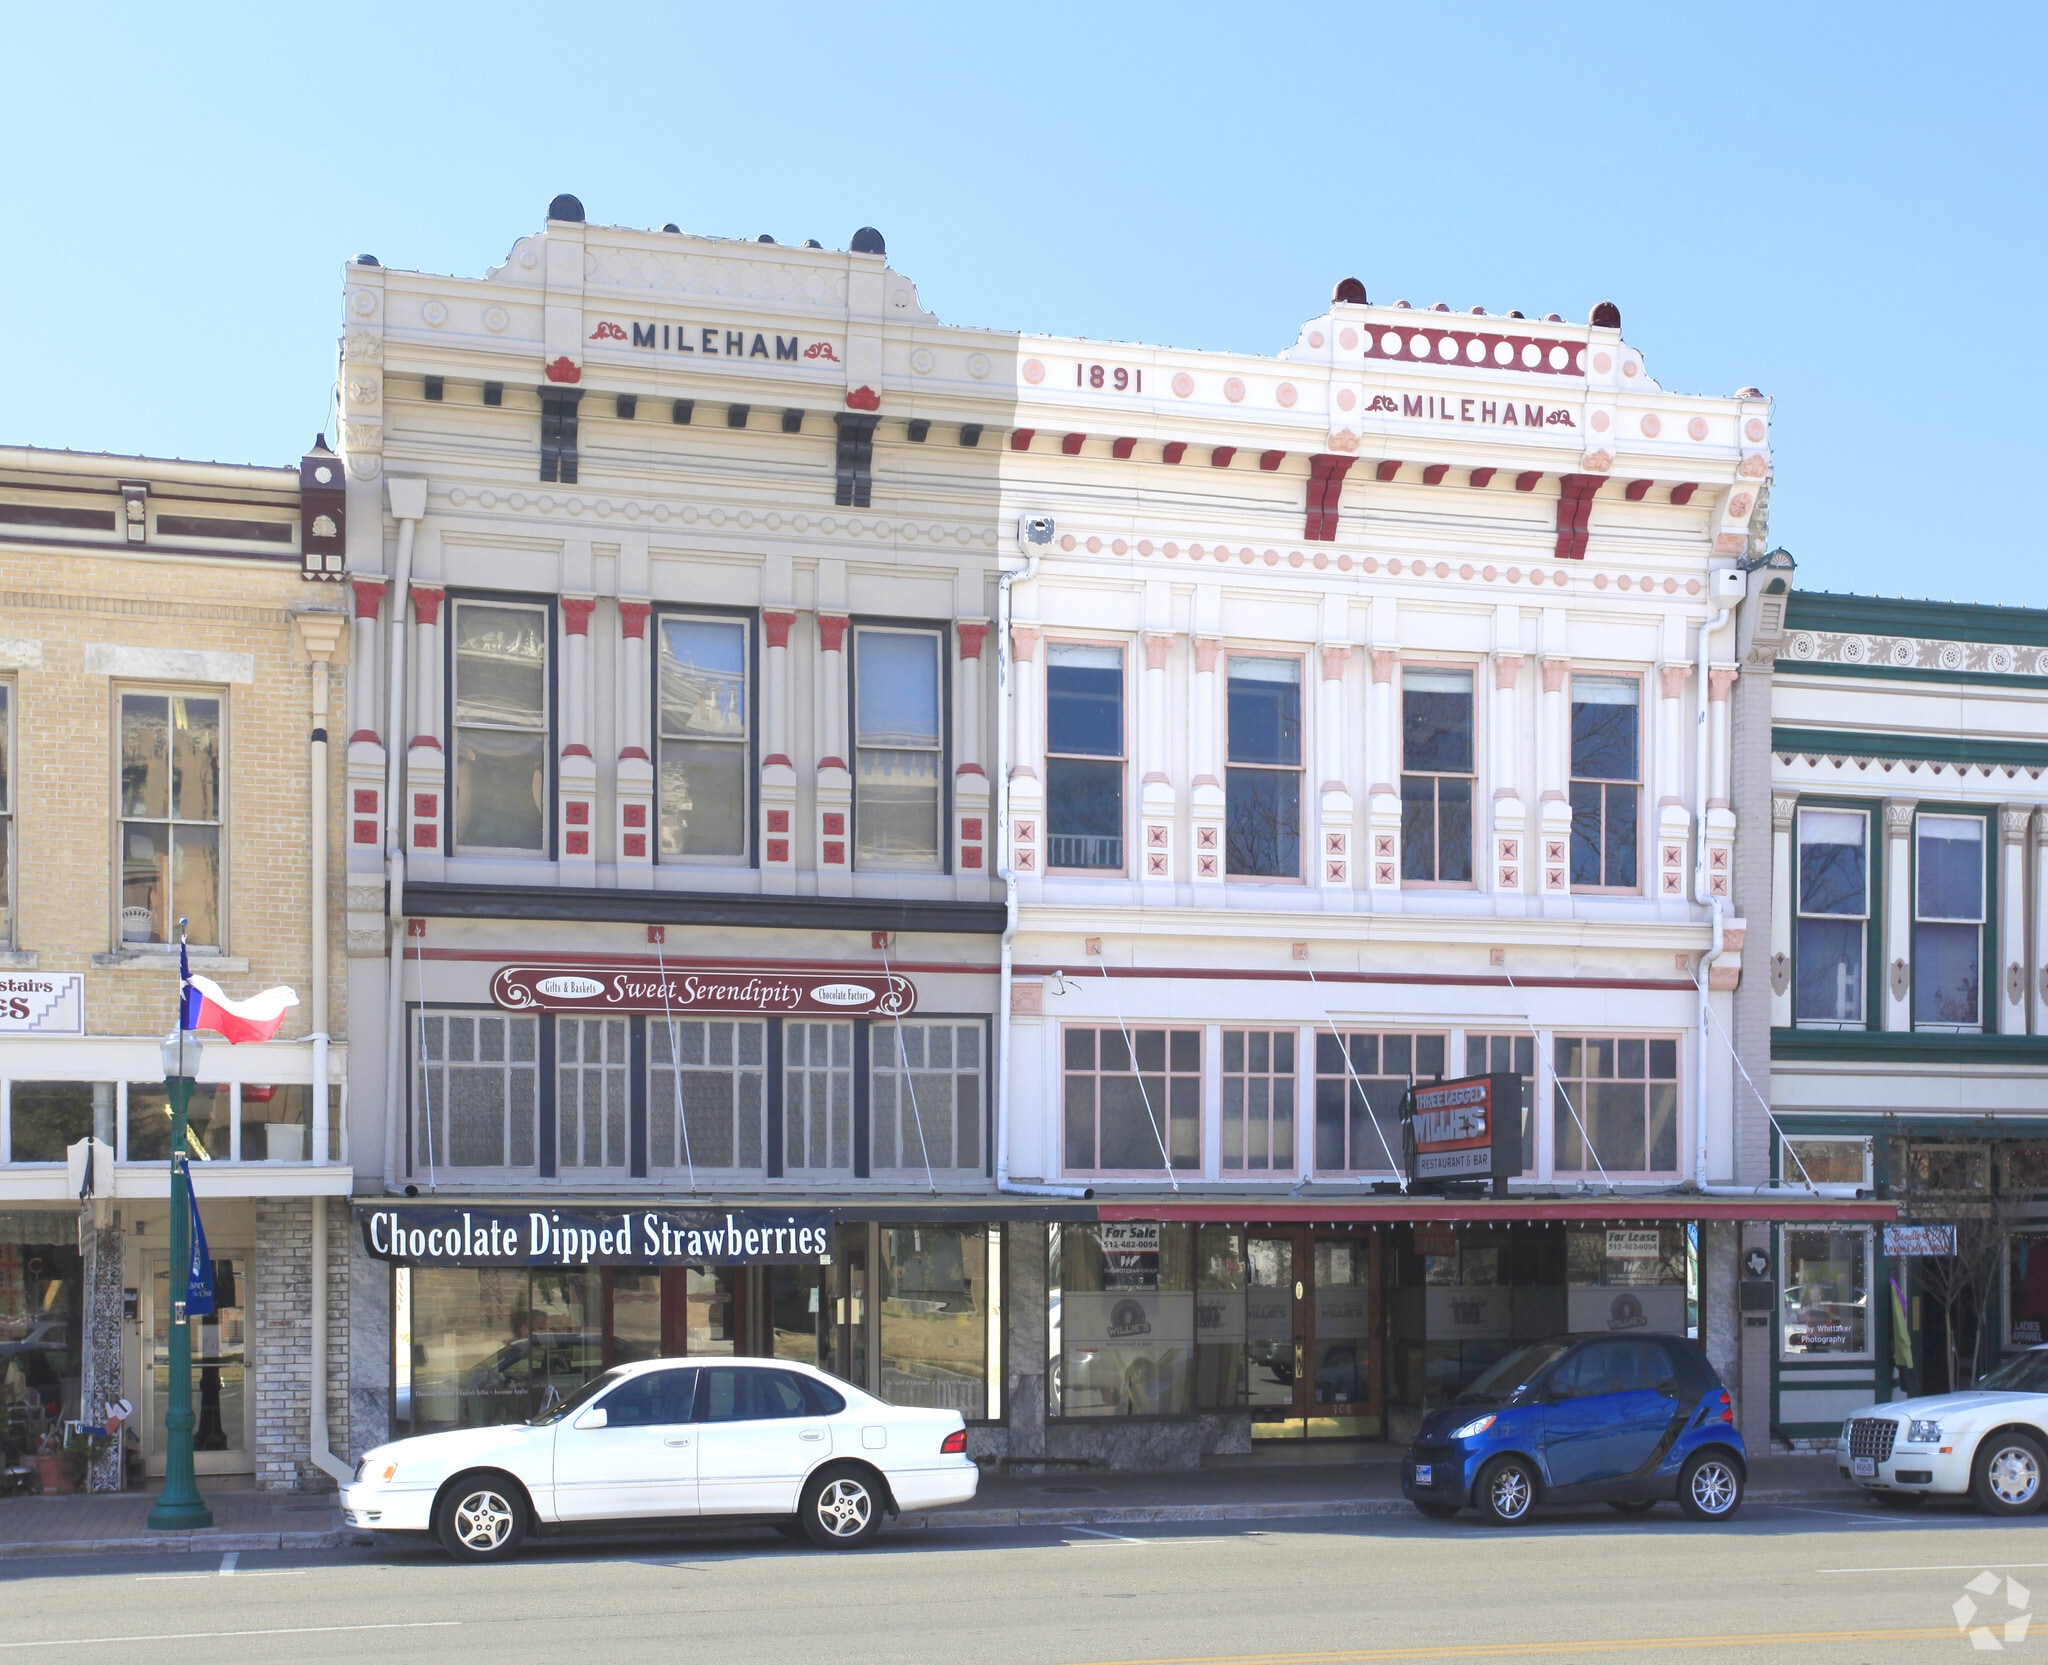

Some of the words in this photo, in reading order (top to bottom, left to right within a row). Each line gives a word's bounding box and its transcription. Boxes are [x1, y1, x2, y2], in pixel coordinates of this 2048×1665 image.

[633, 321, 798, 361] MILEHAM
[1077, 363, 1142, 393] 1891
[1403, 394, 1544, 428] MILEHAM
[545, 981, 561, 993] Gifts
[564, 981, 569, 993] &
[570, 982, 596, 994] Baskets
[606, 975, 677, 1003] Sweet
[678, 977, 803, 1009] Serendipity
[818, 988, 846, 1000] Chocolate
[848, 988, 868, 1002] Factory
[1415, 1092, 1443, 1110] THREE
[1421, 1156, 1464, 1170] RESTAURANT
[1466, 1155, 1471, 1166] &
[1473, 1154, 1488, 1166] BAR
[370, 1212, 518, 1256] Chocolate
[529, 1212, 632, 1264] Dipped
[644, 1213, 827, 1256] Strawberries
[1105, 1227, 1126, 1238] For
[1129, 1227, 1157, 1239] Sale
[1608, 1232, 1626, 1242] For
[1628, 1232, 1657, 1242] Lease
[1817, 1324, 1852, 1332] Whittaker
[1801, 1336, 1846, 1344] Photography
